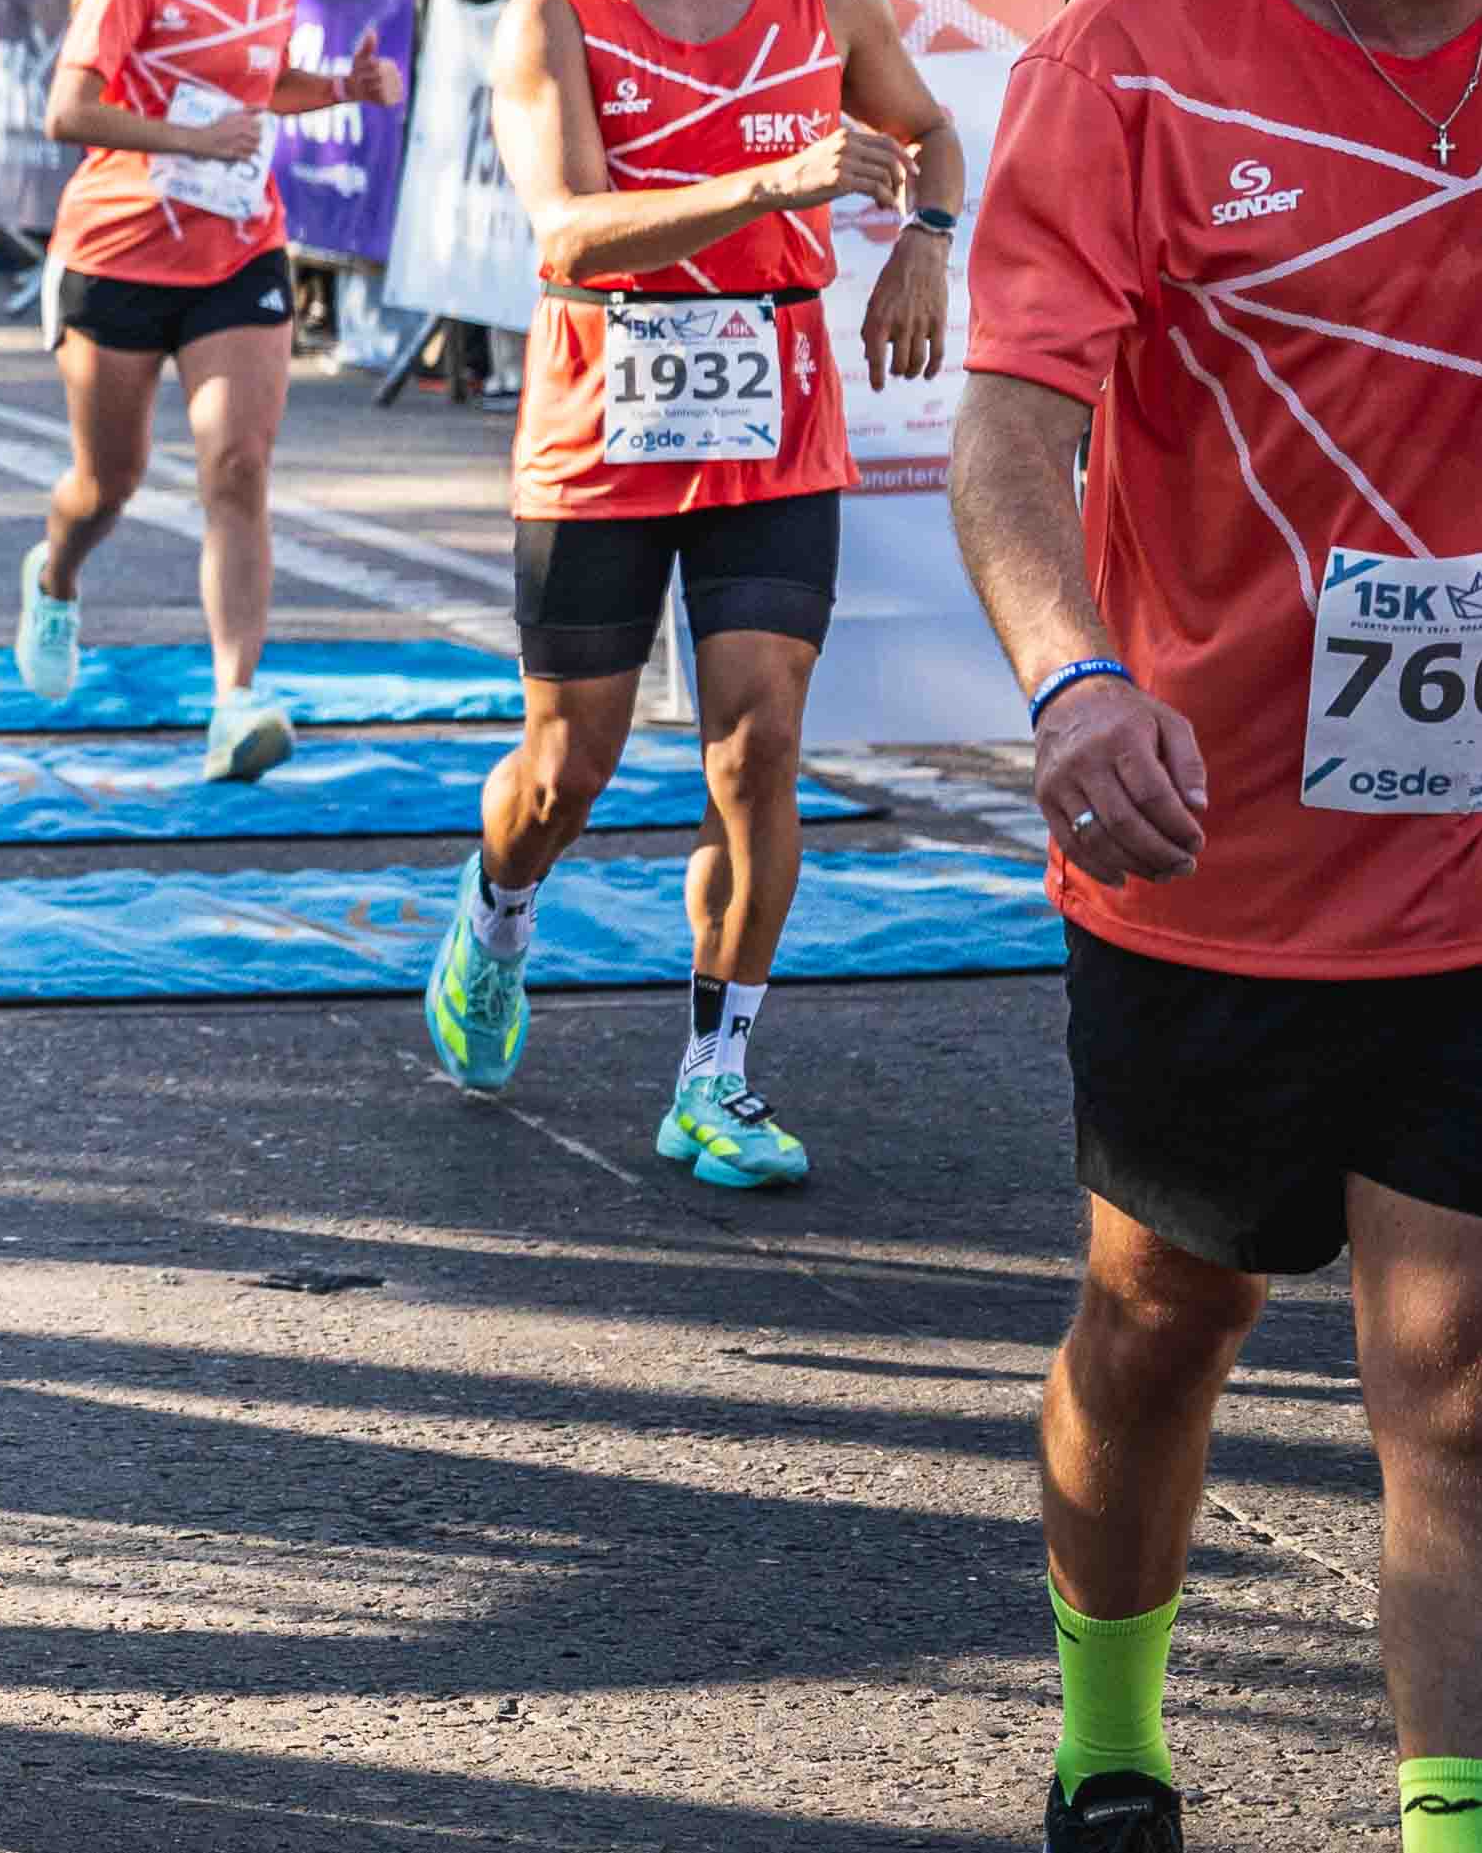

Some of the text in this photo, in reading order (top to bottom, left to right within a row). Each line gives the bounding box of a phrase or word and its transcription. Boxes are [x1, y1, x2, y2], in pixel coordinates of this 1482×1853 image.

[739, 112, 795, 145] 15K
[613, 351, 773, 403] 1932
[1354, 580, 1438, 622] 15K
[1324, 636, 1482, 724] 76
[1349, 766, 1452, 801] osde
